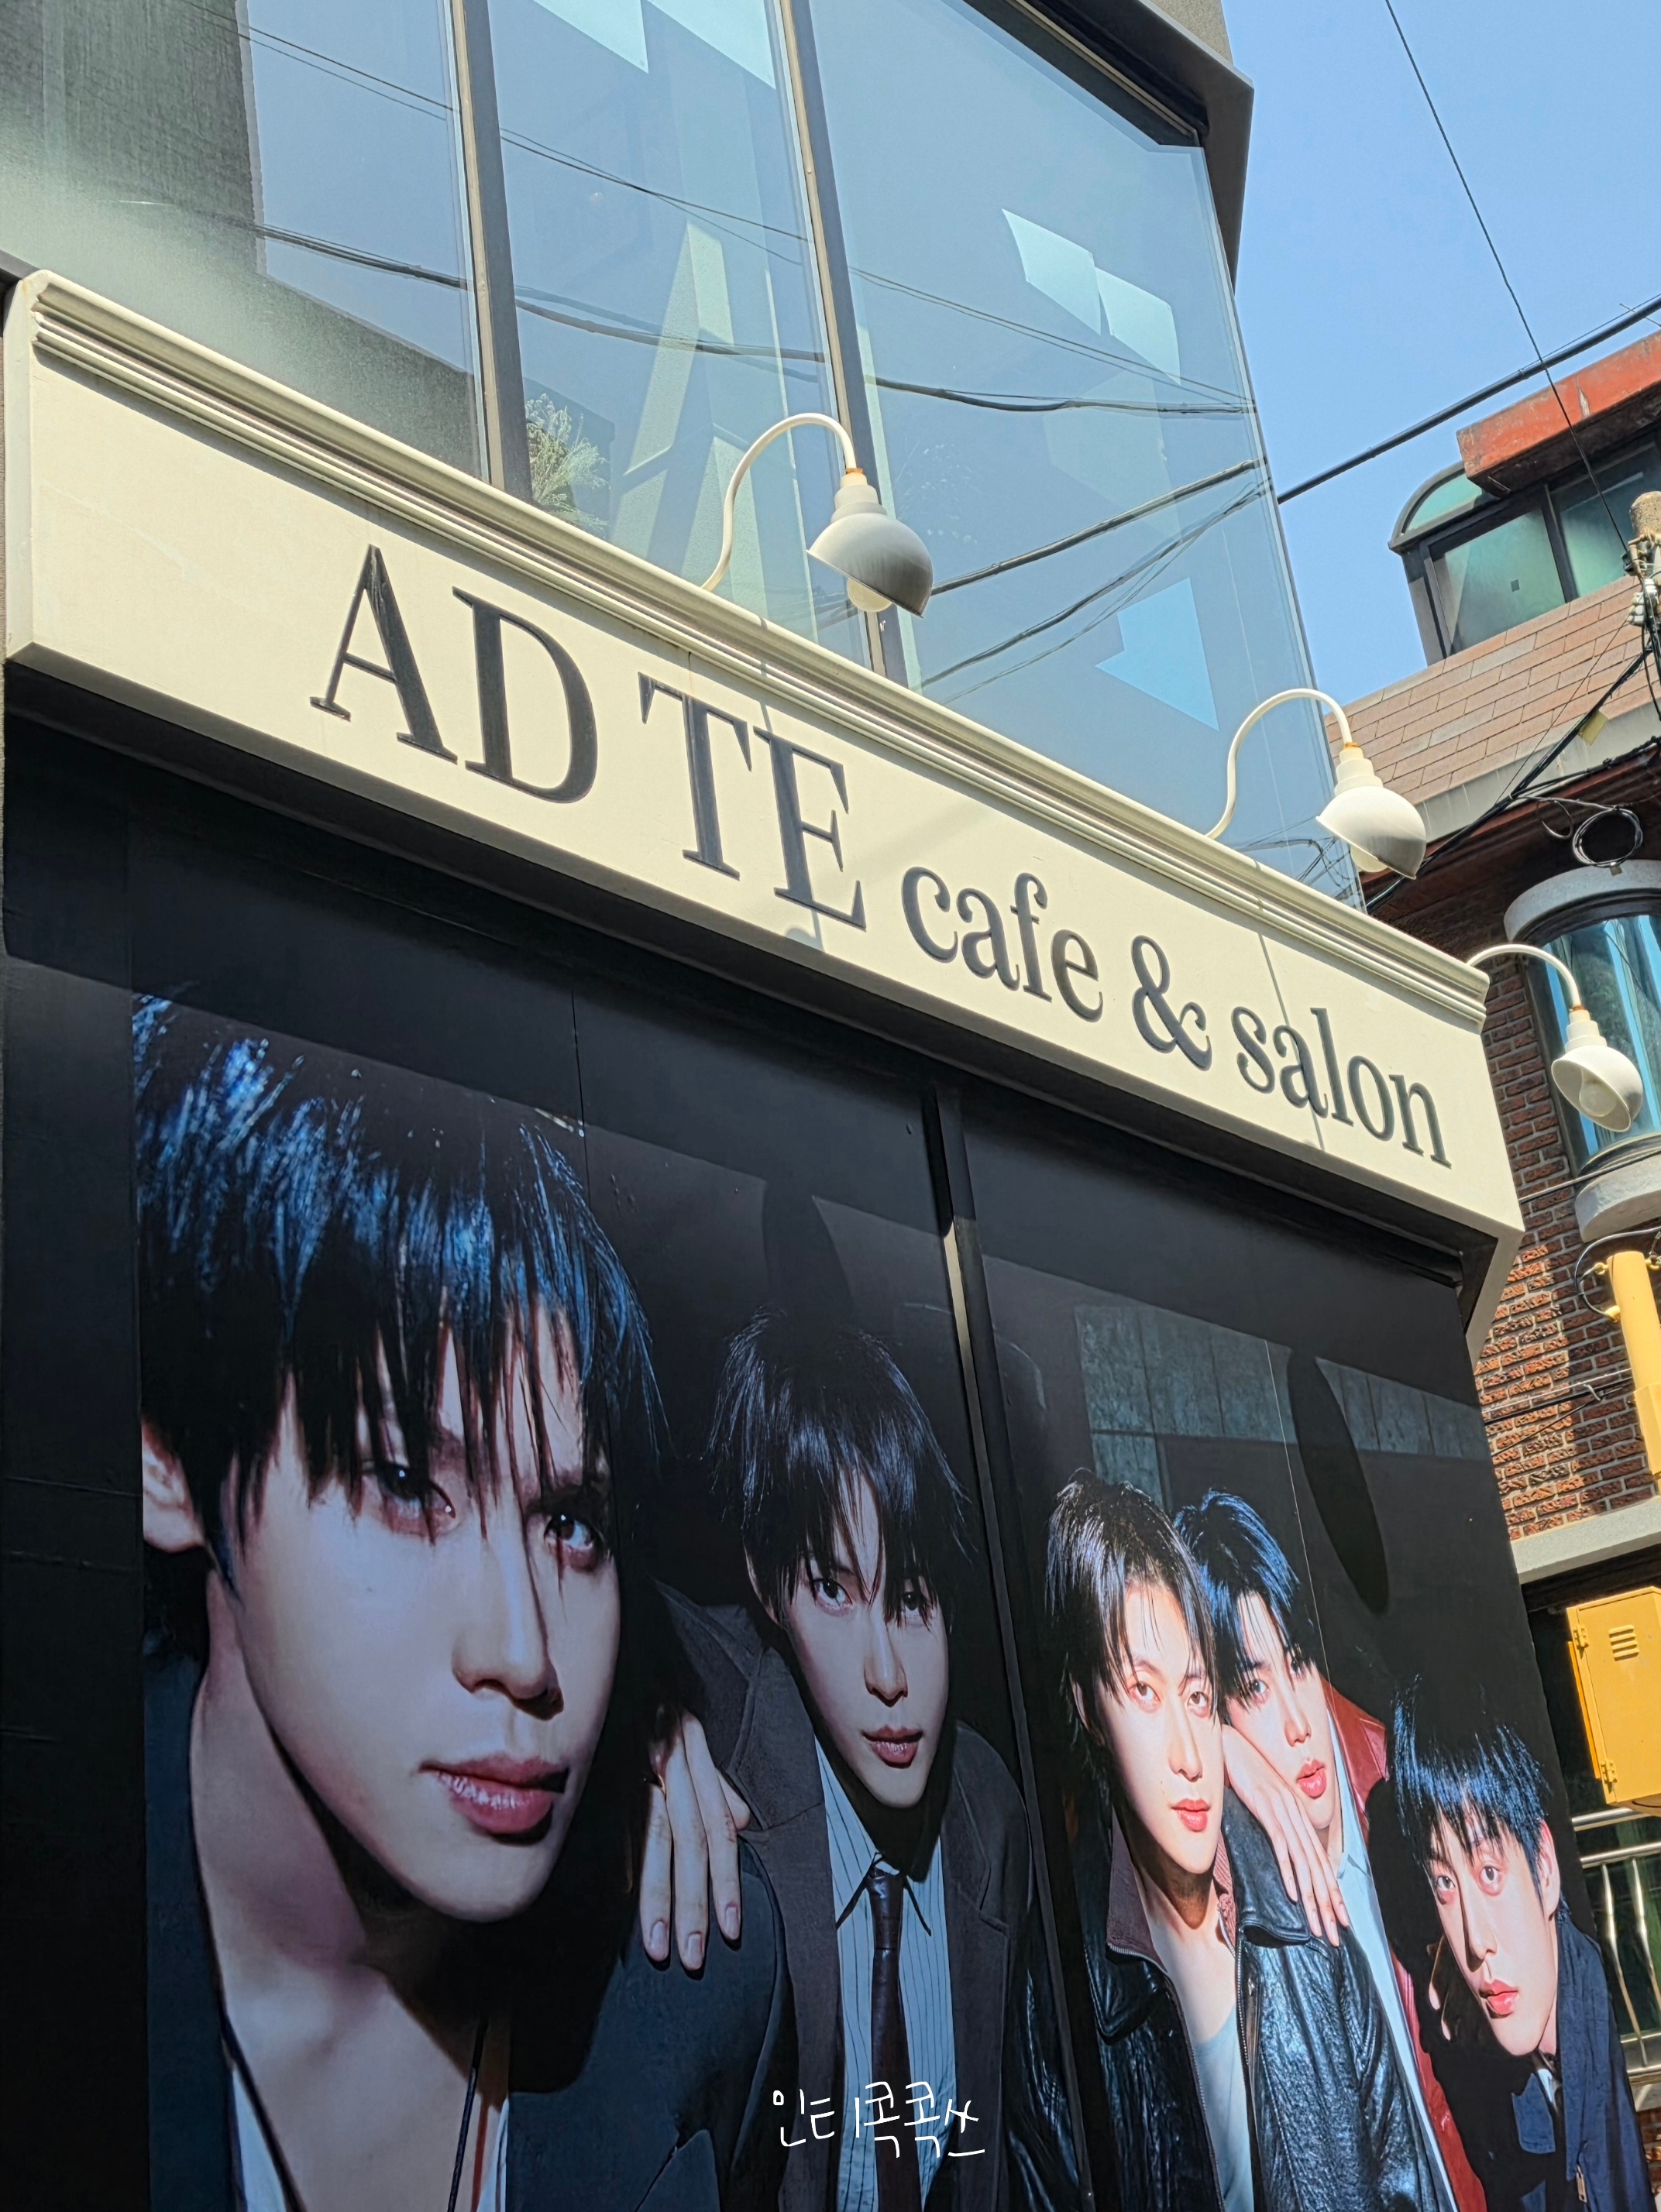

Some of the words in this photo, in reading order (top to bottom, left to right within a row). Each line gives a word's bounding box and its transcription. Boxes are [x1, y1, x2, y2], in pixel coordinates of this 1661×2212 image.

[310, 544, 598, 803] AD
[638, 672, 866, 932] TE
[901, 867, 1103, 1022] cafe
[1130, 935, 1212, 1071] &
[1231, 1007, 1452, 1169] salon
